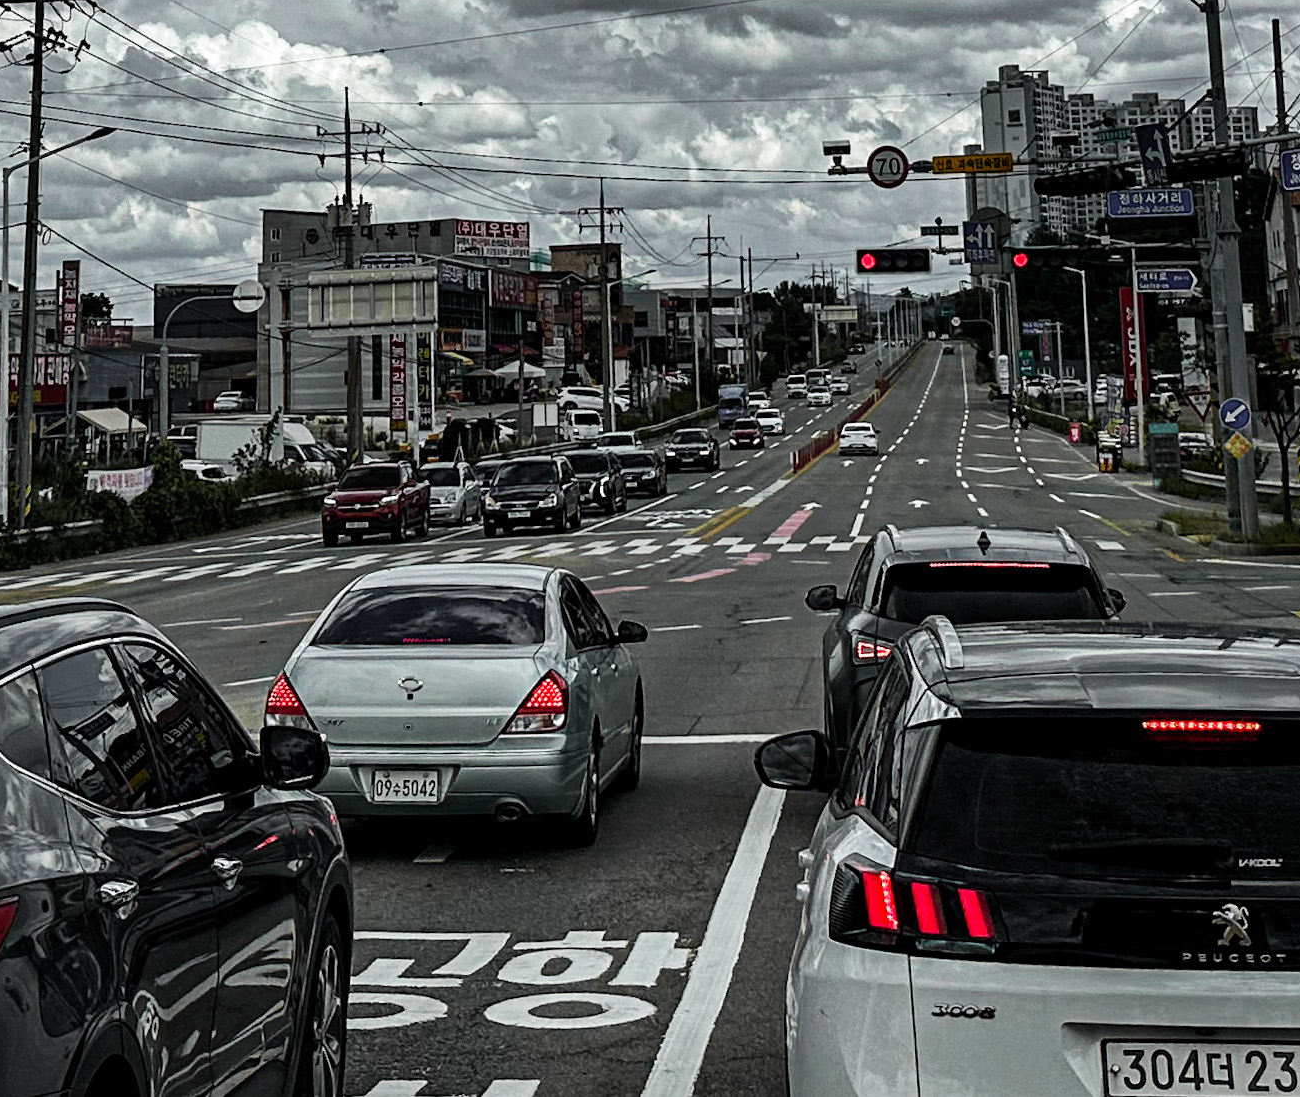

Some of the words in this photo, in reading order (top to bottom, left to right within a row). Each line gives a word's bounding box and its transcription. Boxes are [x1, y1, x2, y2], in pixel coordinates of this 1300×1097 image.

[875, 157, 901, 177] 70
[1119, 191, 1183, 206] 정하사거리
[376, 779, 436, 796] 09수5042
[1181, 952, 1287, 963] PEUGEOT
[346, 930, 698, 1029] 공항
[931, 1003, 996, 1020] 3008
[1122, 1048, 1235, 1091] 304더
